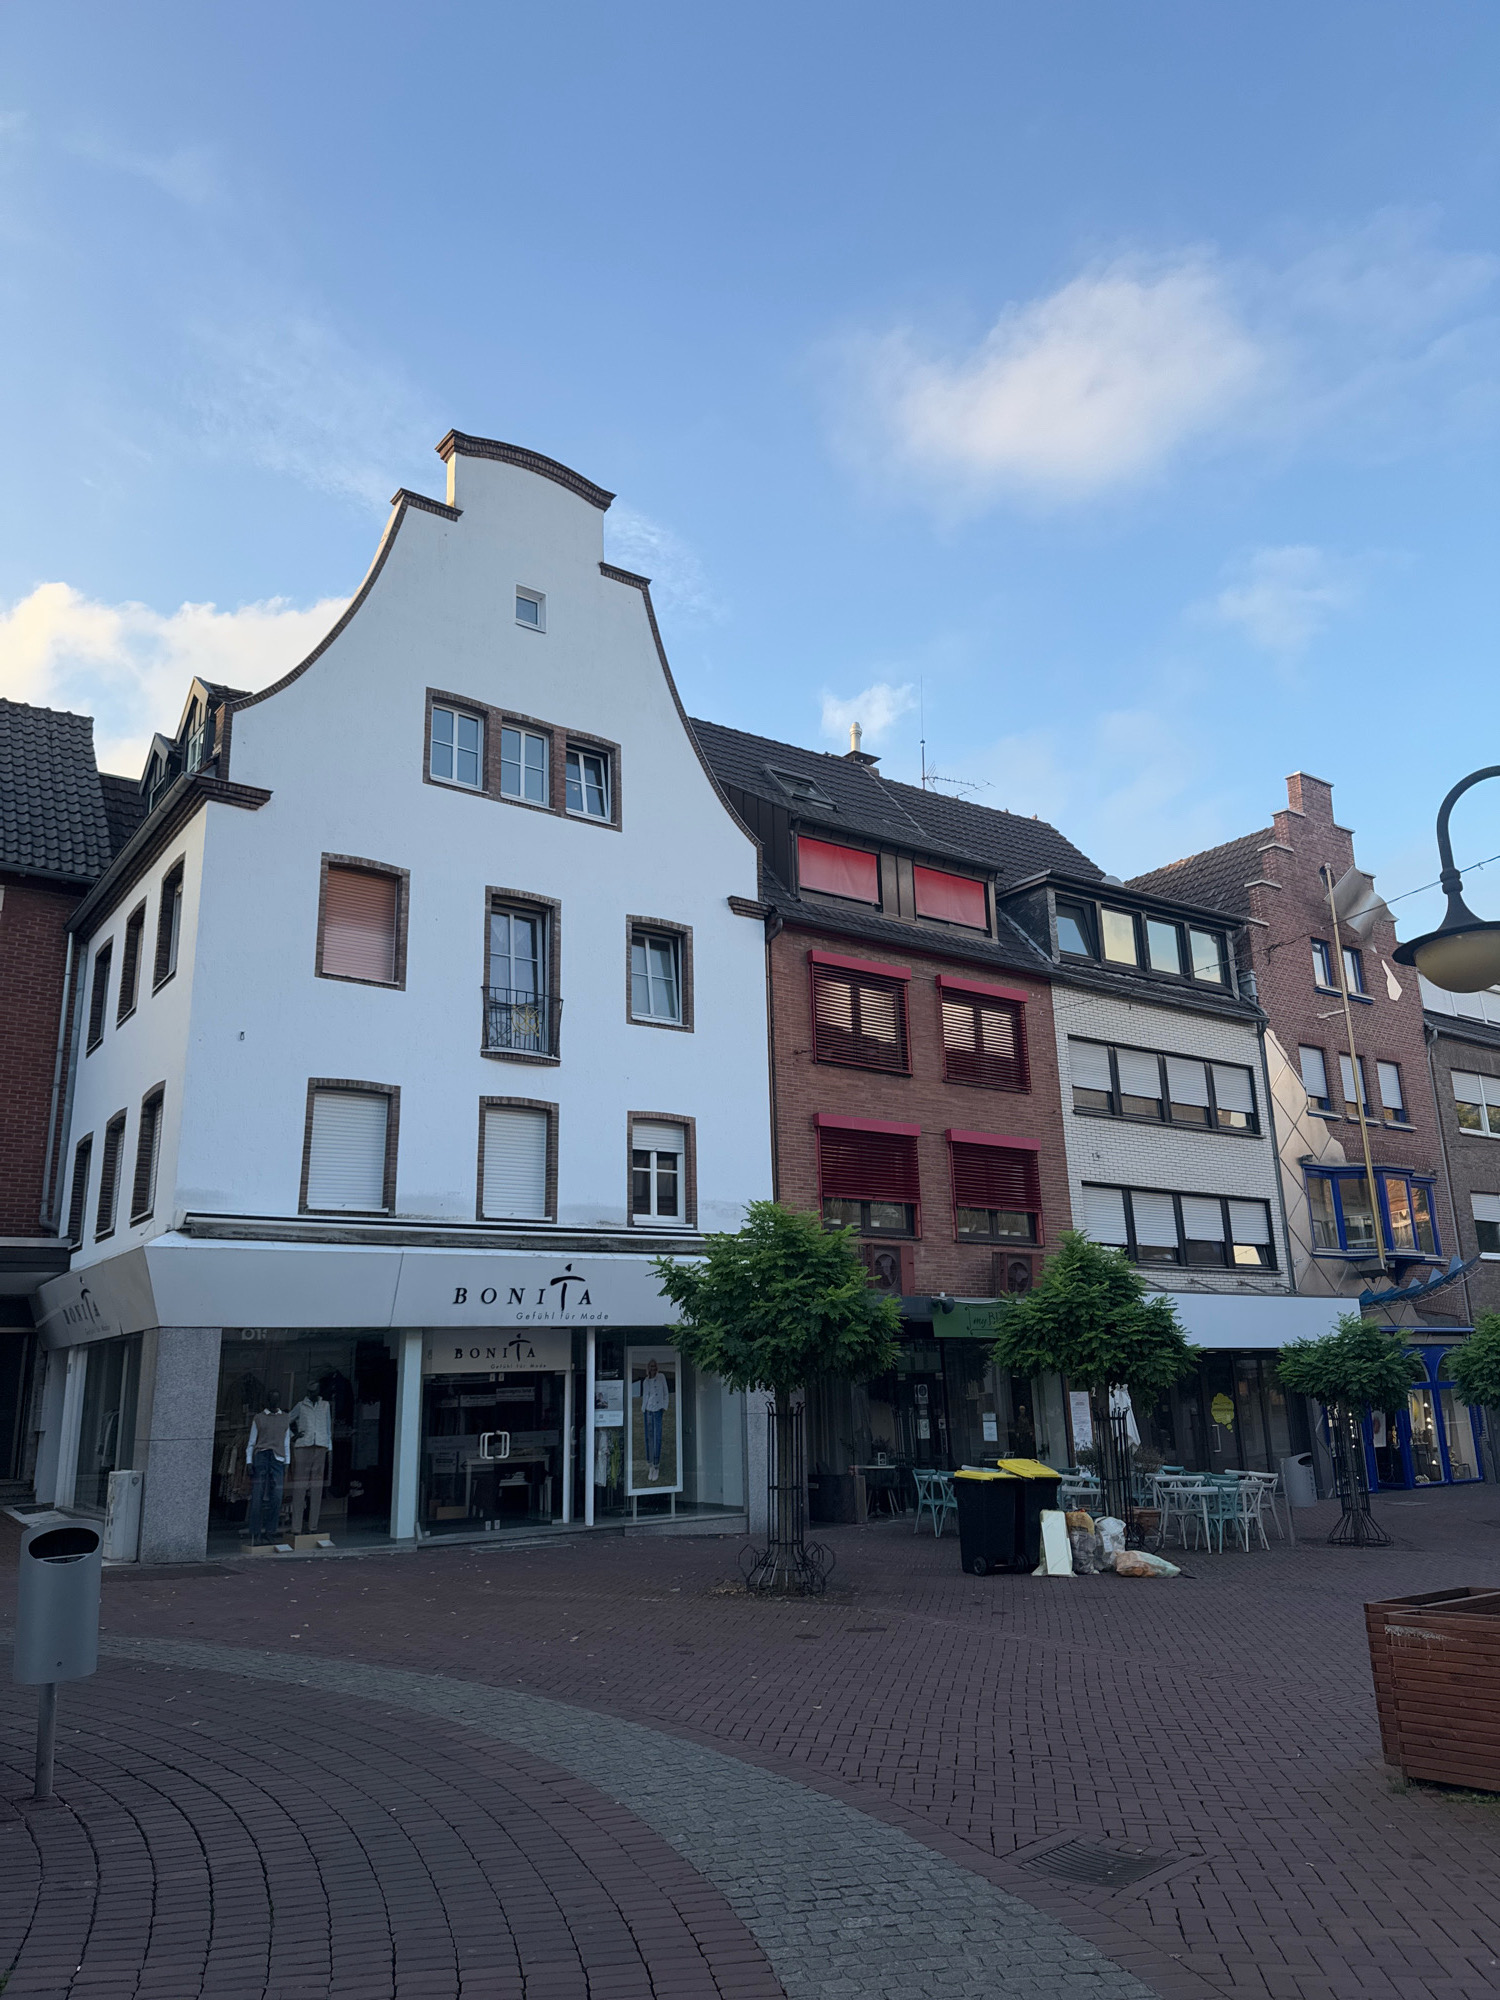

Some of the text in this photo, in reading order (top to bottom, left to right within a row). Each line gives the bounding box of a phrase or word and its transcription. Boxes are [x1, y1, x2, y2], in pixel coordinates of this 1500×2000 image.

[452, 1263, 592, 1312] BONITA
[516, 1311, 609, 1321] Gefühl für Mode
[454, 1333, 536, 1362] BONITA
